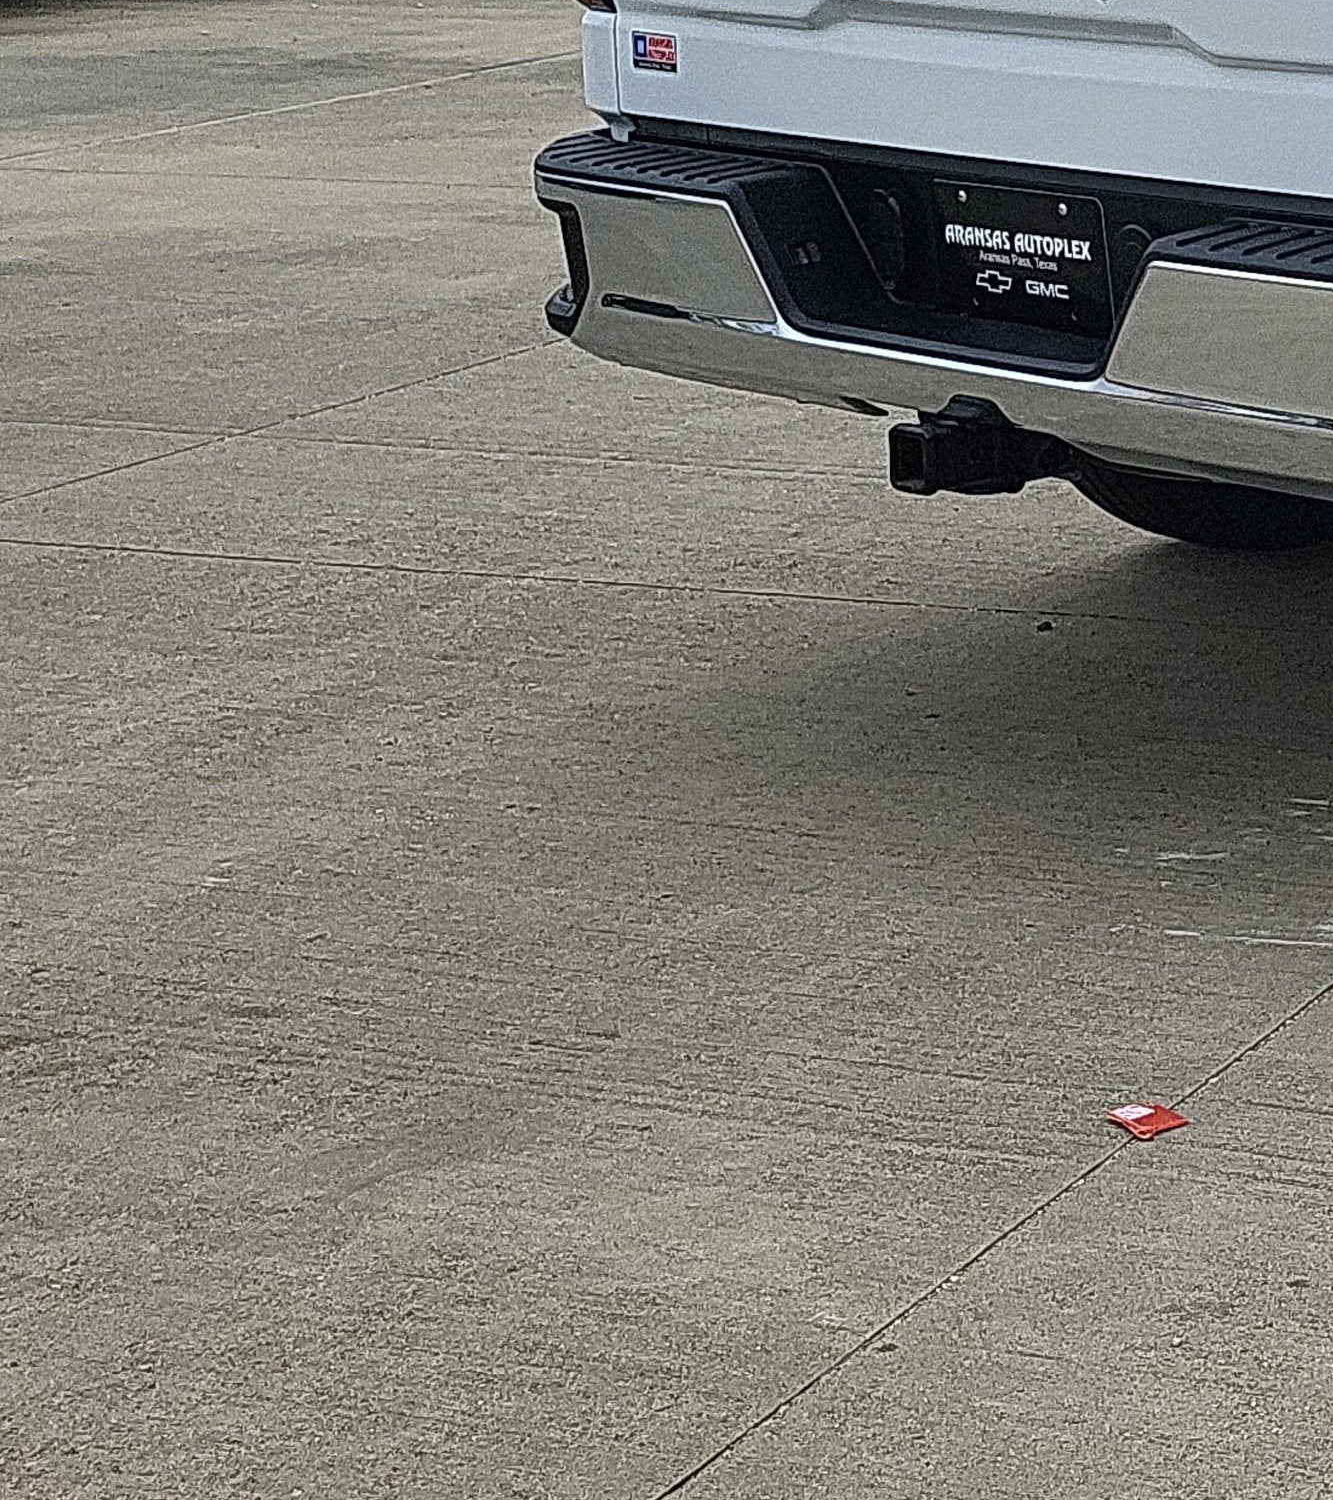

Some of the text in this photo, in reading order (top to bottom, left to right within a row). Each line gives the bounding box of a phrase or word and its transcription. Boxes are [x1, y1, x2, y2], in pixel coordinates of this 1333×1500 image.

[945, 223, 1092, 261] ARANSAS AUTOPLEX
[1033, 257, 1058, 272] Texas
[1025, 280, 1070, 300] GMC
